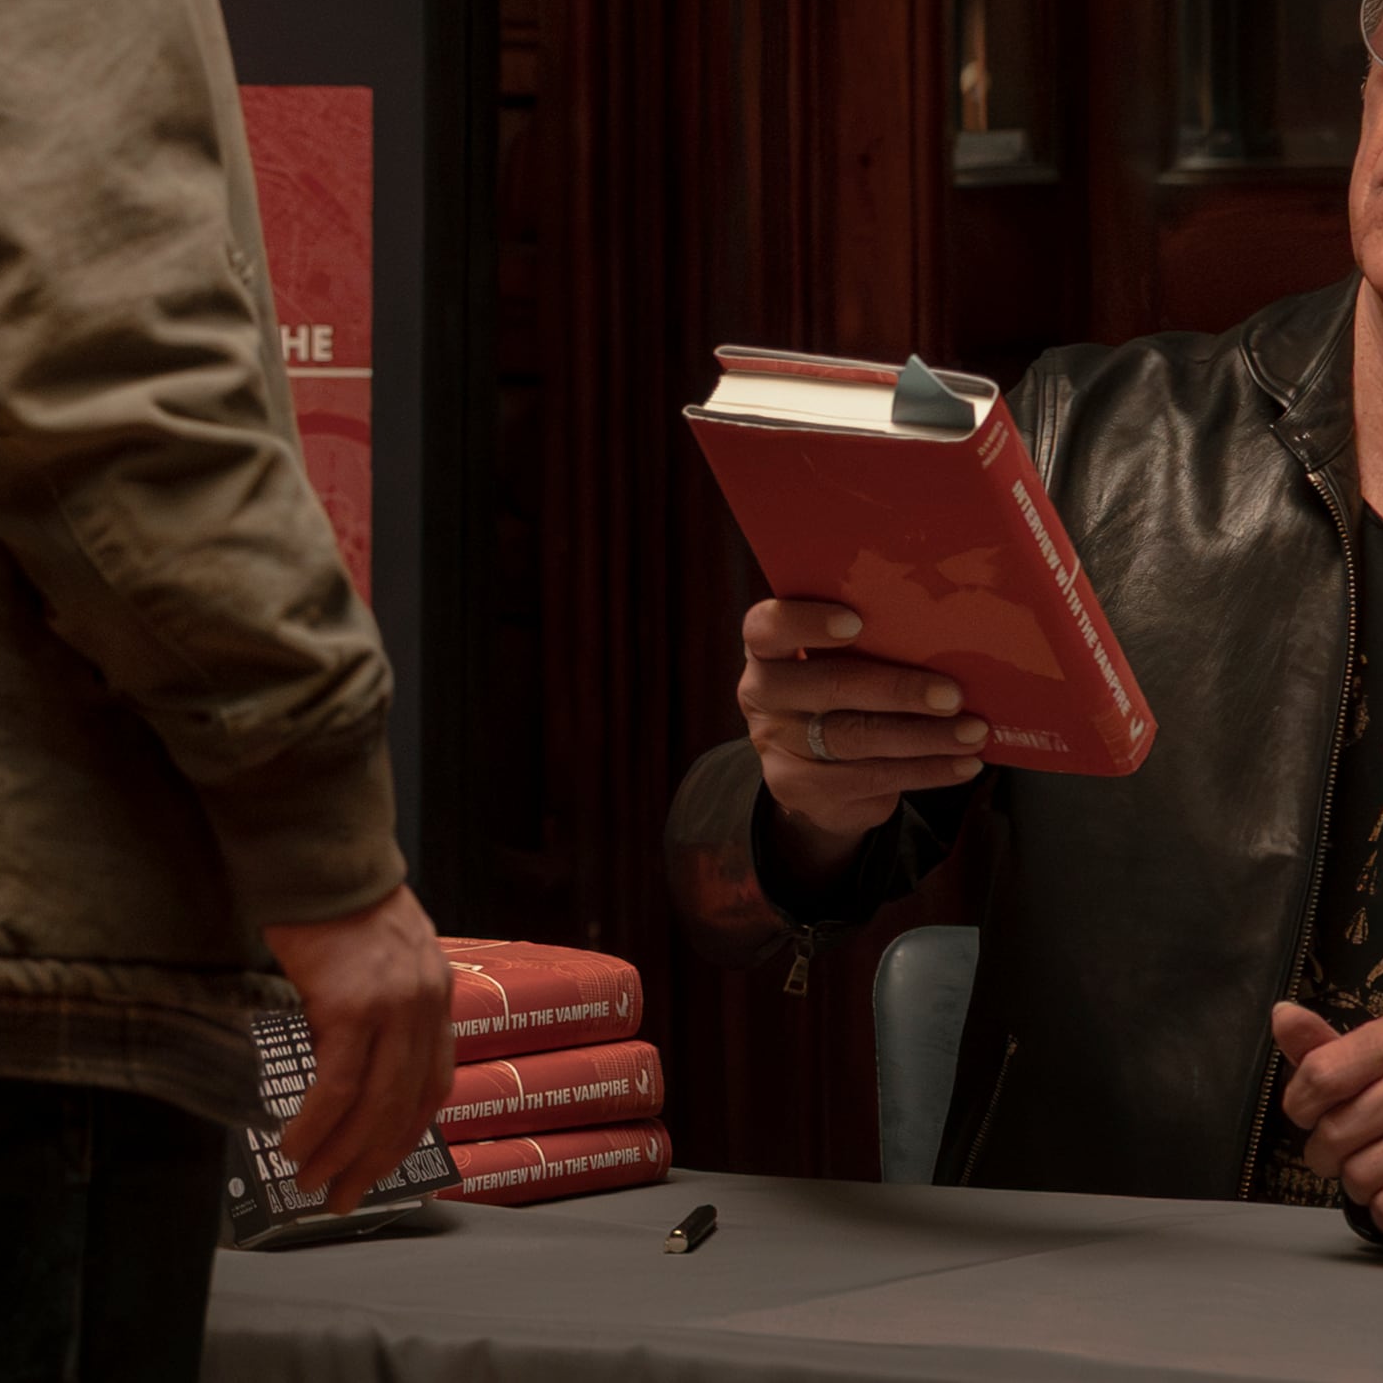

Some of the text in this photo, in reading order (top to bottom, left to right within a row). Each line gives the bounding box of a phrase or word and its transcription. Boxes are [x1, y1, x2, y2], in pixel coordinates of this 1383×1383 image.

[492, 1012, 527, 1031] WITH
[529, 1009, 554, 1027] THE
[555, 1000, 610, 1023] VAMPIRE
[506, 1093, 544, 1112] WITH
[545, 1088, 571, 1107] THE
[572, 1078, 630, 1102] VAMPIRE
[462, 1146, 642, 1195] INTERVIEW WITH THE VAMPIRE
